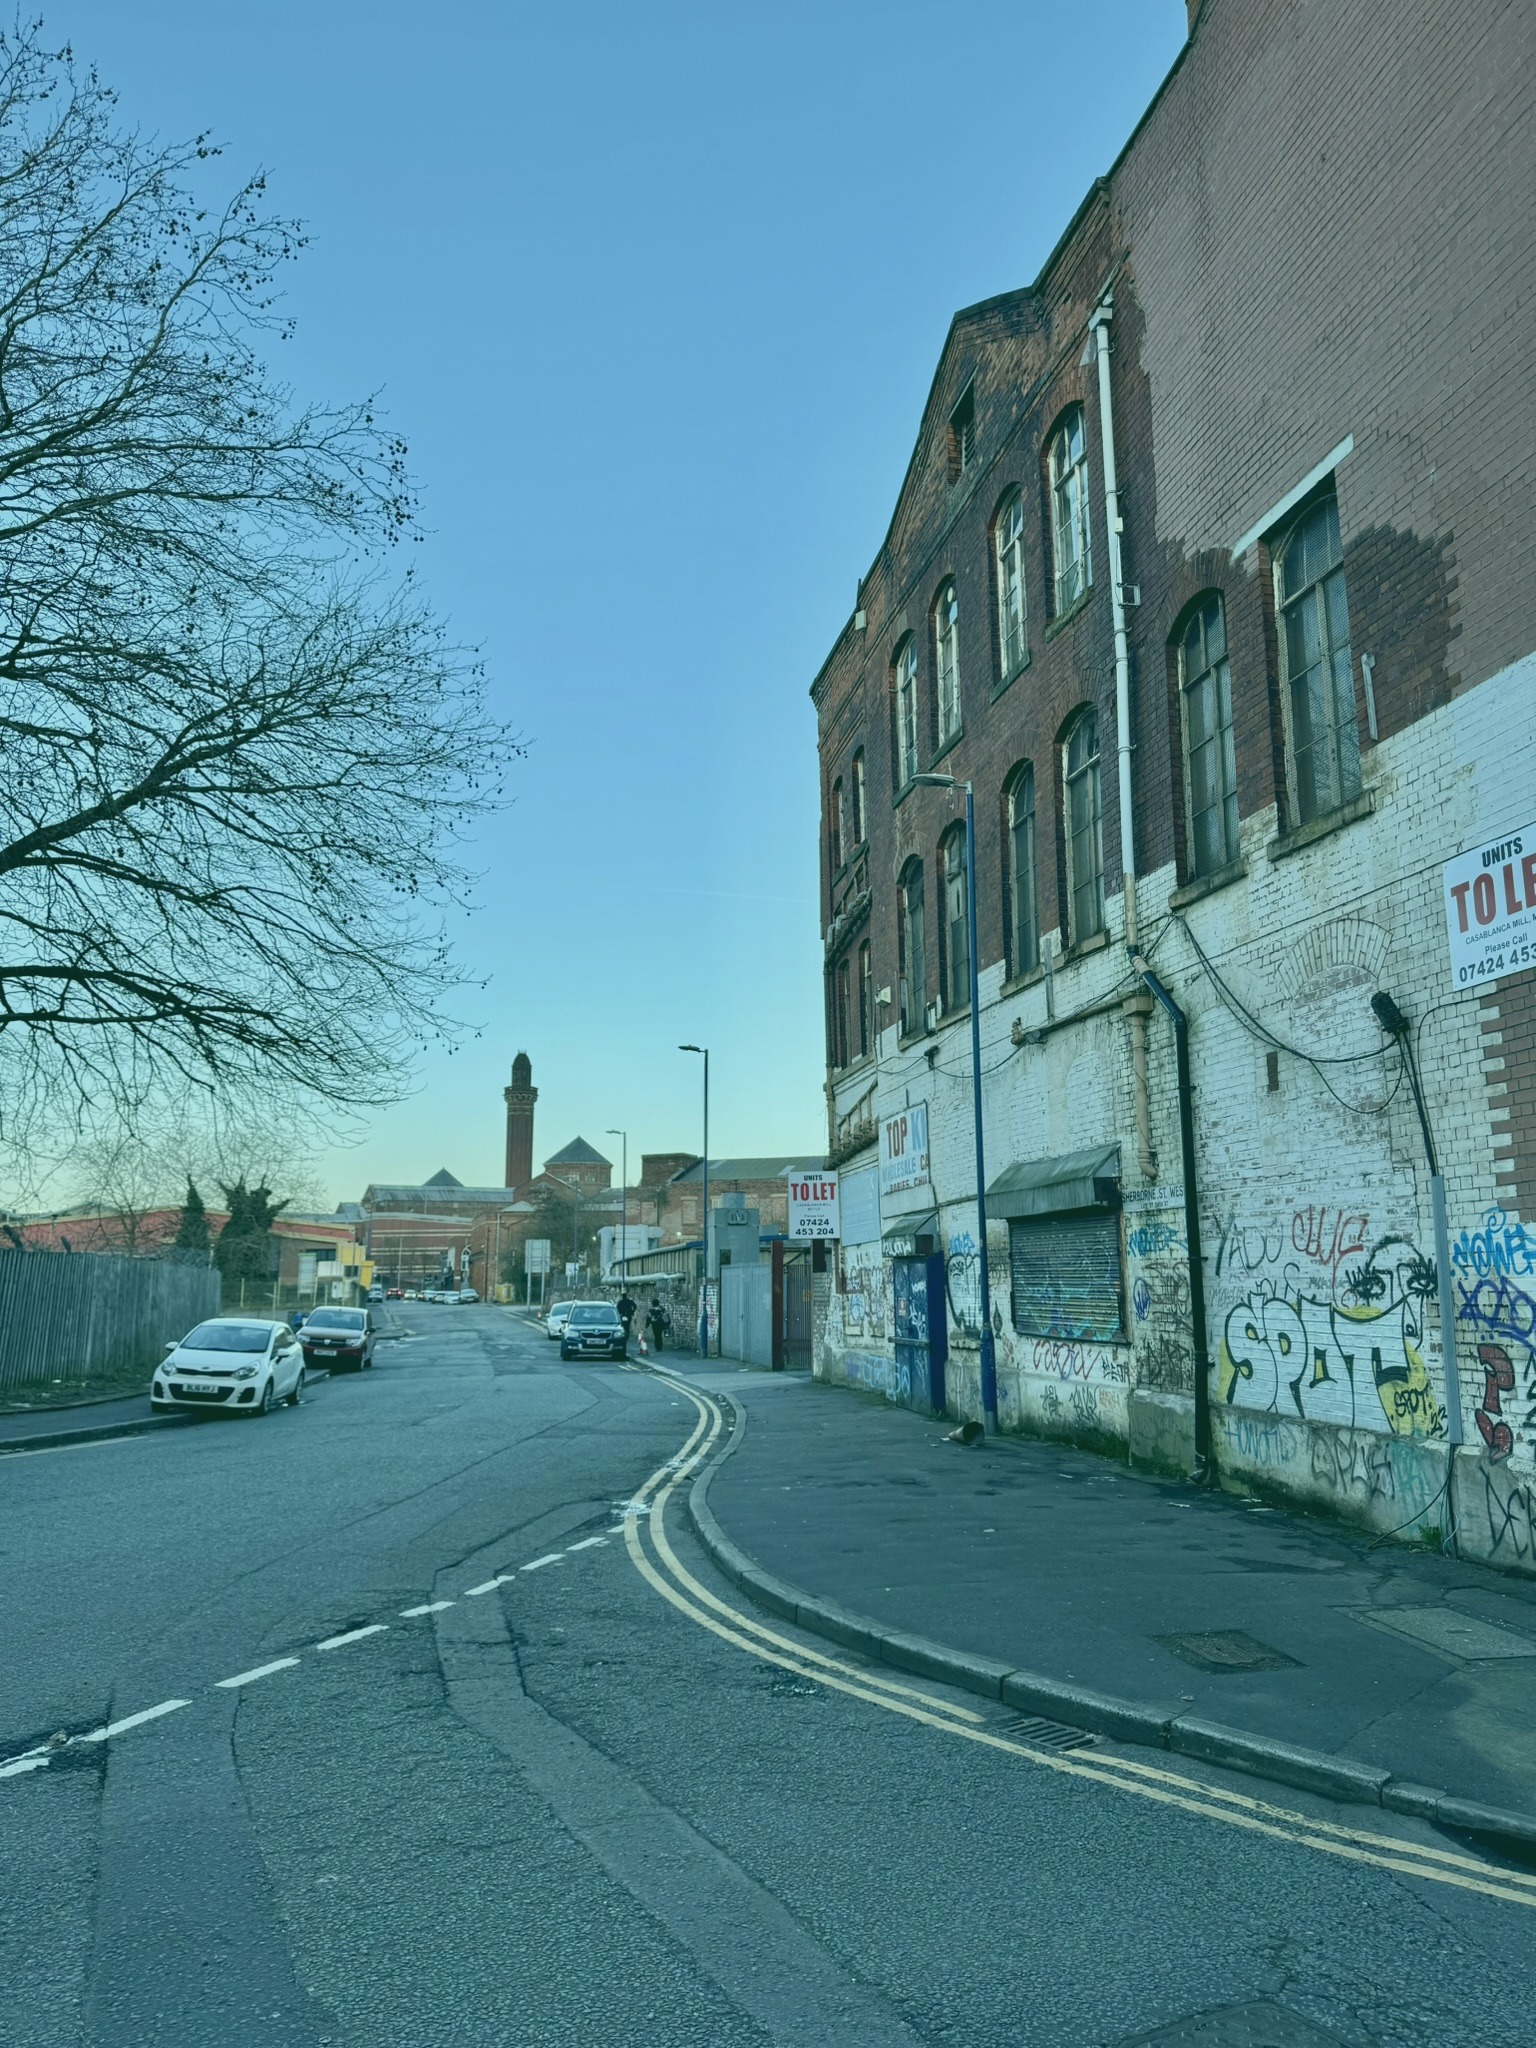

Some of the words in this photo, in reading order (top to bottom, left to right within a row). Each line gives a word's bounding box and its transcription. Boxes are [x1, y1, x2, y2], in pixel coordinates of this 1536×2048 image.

[1482, 837, 1523, 868] UNITS
[1450, 872, 1496, 934] TO
[1465, 922, 1511, 945] CASABLANCA
[1512, 916, 1532, 928] MILL,
[1485, 940, 1510, 955] Please
[1512, 932, 1528, 945] Call
[1459, 954, 1505, 983] 07424
[1509, 942, 1536, 966] 453
[886, 1116, 907, 1159] TOP
[790, 1182, 810, 1201] TO
[813, 1182, 836, 1201] LET
[1169, 1185, 1184, 1198] WES
[795, 1228, 814, 1236] 453
[816, 1228, 834, 1236] 204
[799, 1219, 830, 1227] 07424
[1394, 1382, 1430, 1418] SPOT
